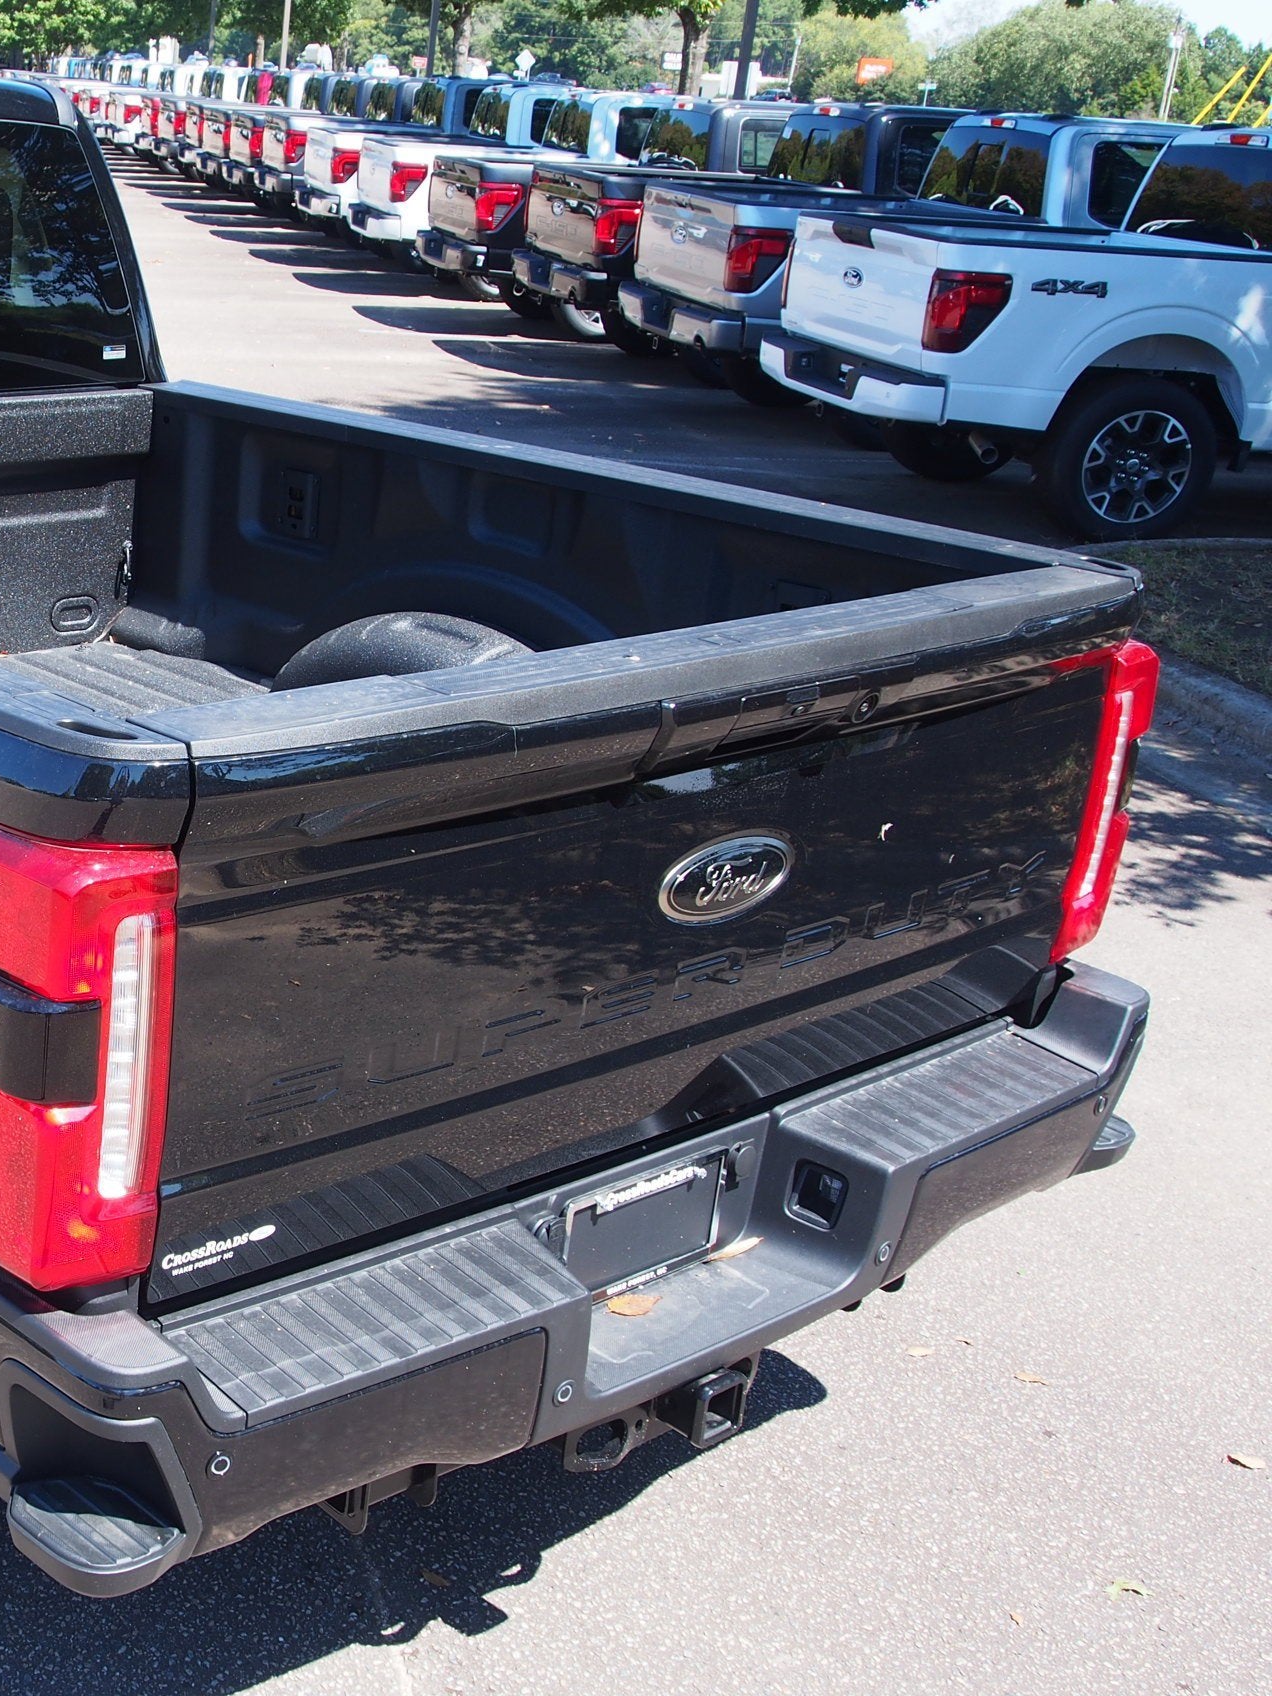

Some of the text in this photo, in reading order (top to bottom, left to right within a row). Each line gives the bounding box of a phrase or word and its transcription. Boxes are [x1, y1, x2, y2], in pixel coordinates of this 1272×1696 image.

[695, 855, 767, 907] Ford
[243, 850, 1047, 1123] SUPER DUTY
[171, 1251, 234, 1277] WAKE FOREST NC
